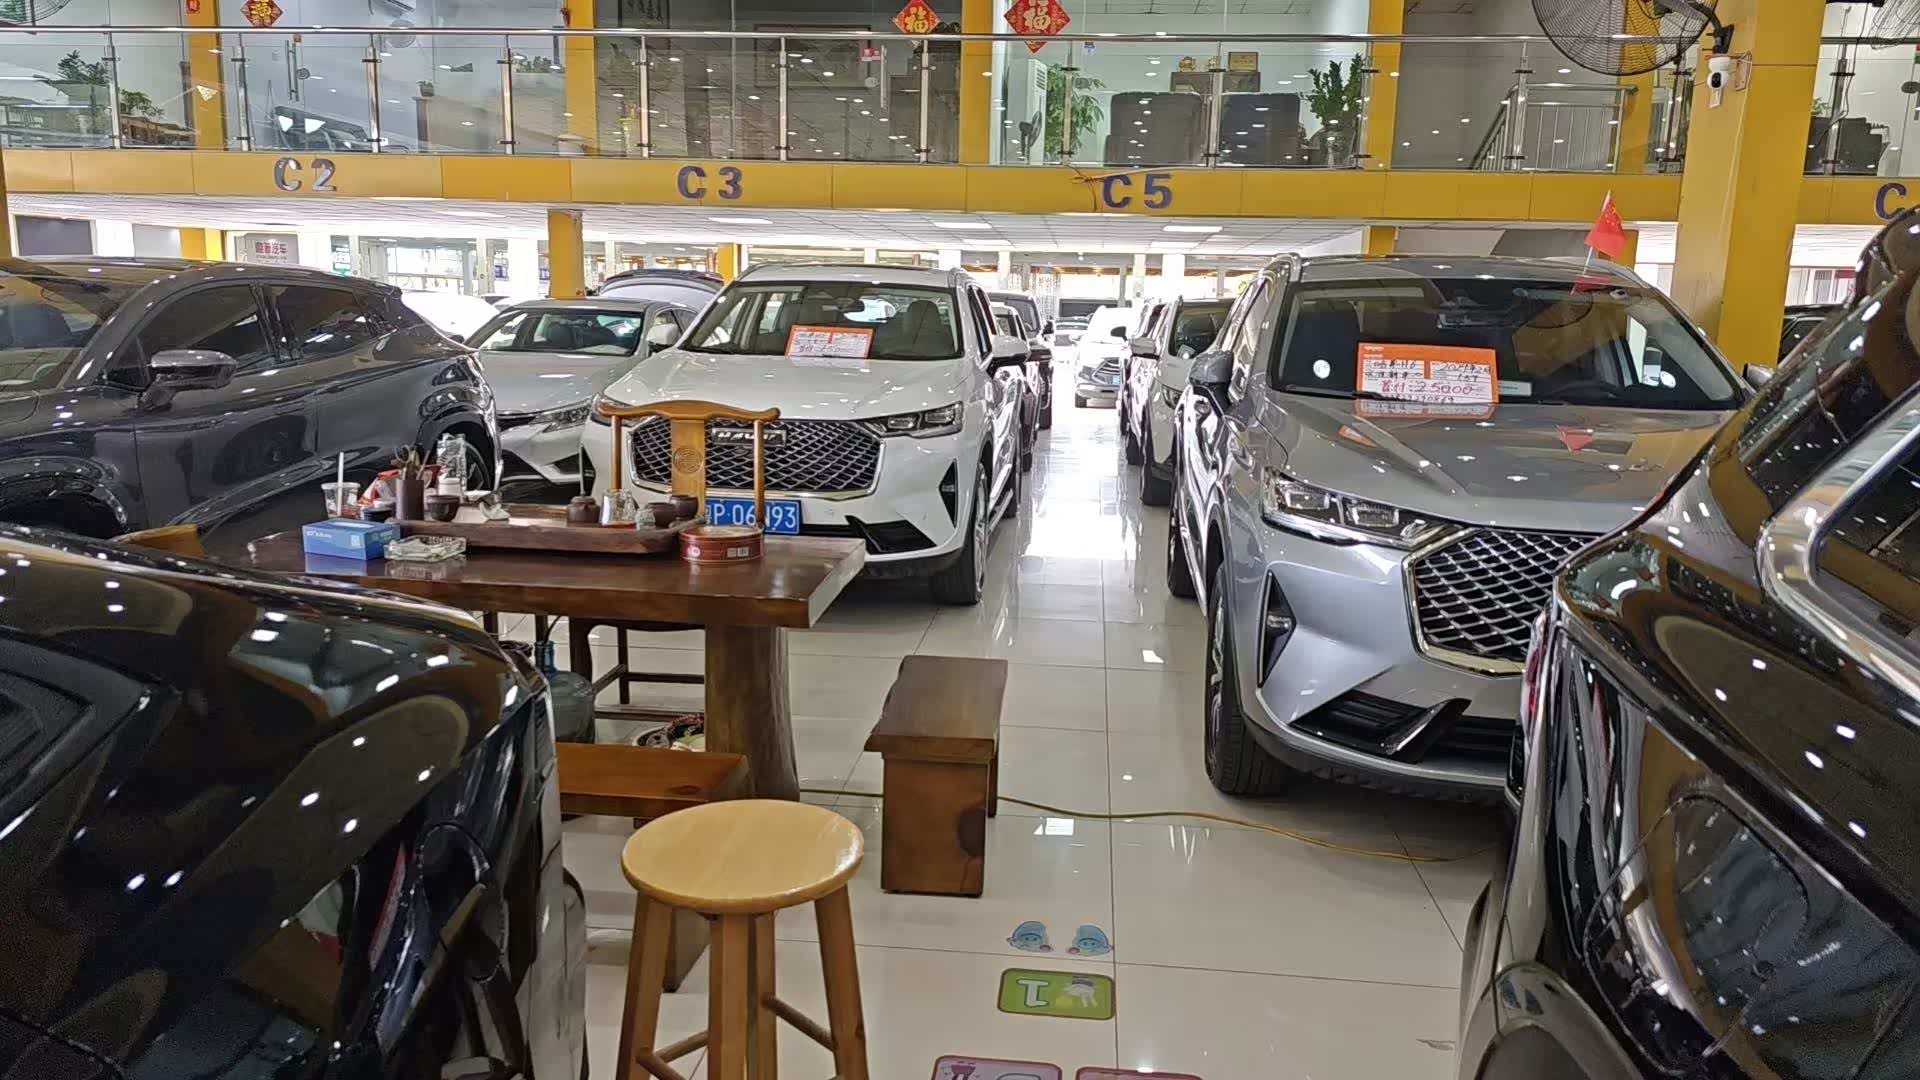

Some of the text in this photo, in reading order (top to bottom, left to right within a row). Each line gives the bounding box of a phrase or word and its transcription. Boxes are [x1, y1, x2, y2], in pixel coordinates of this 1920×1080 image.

[274, 157, 338, 191] C2
[677, 165, 743, 199] C3
[1103, 173, 1173, 209] C5
